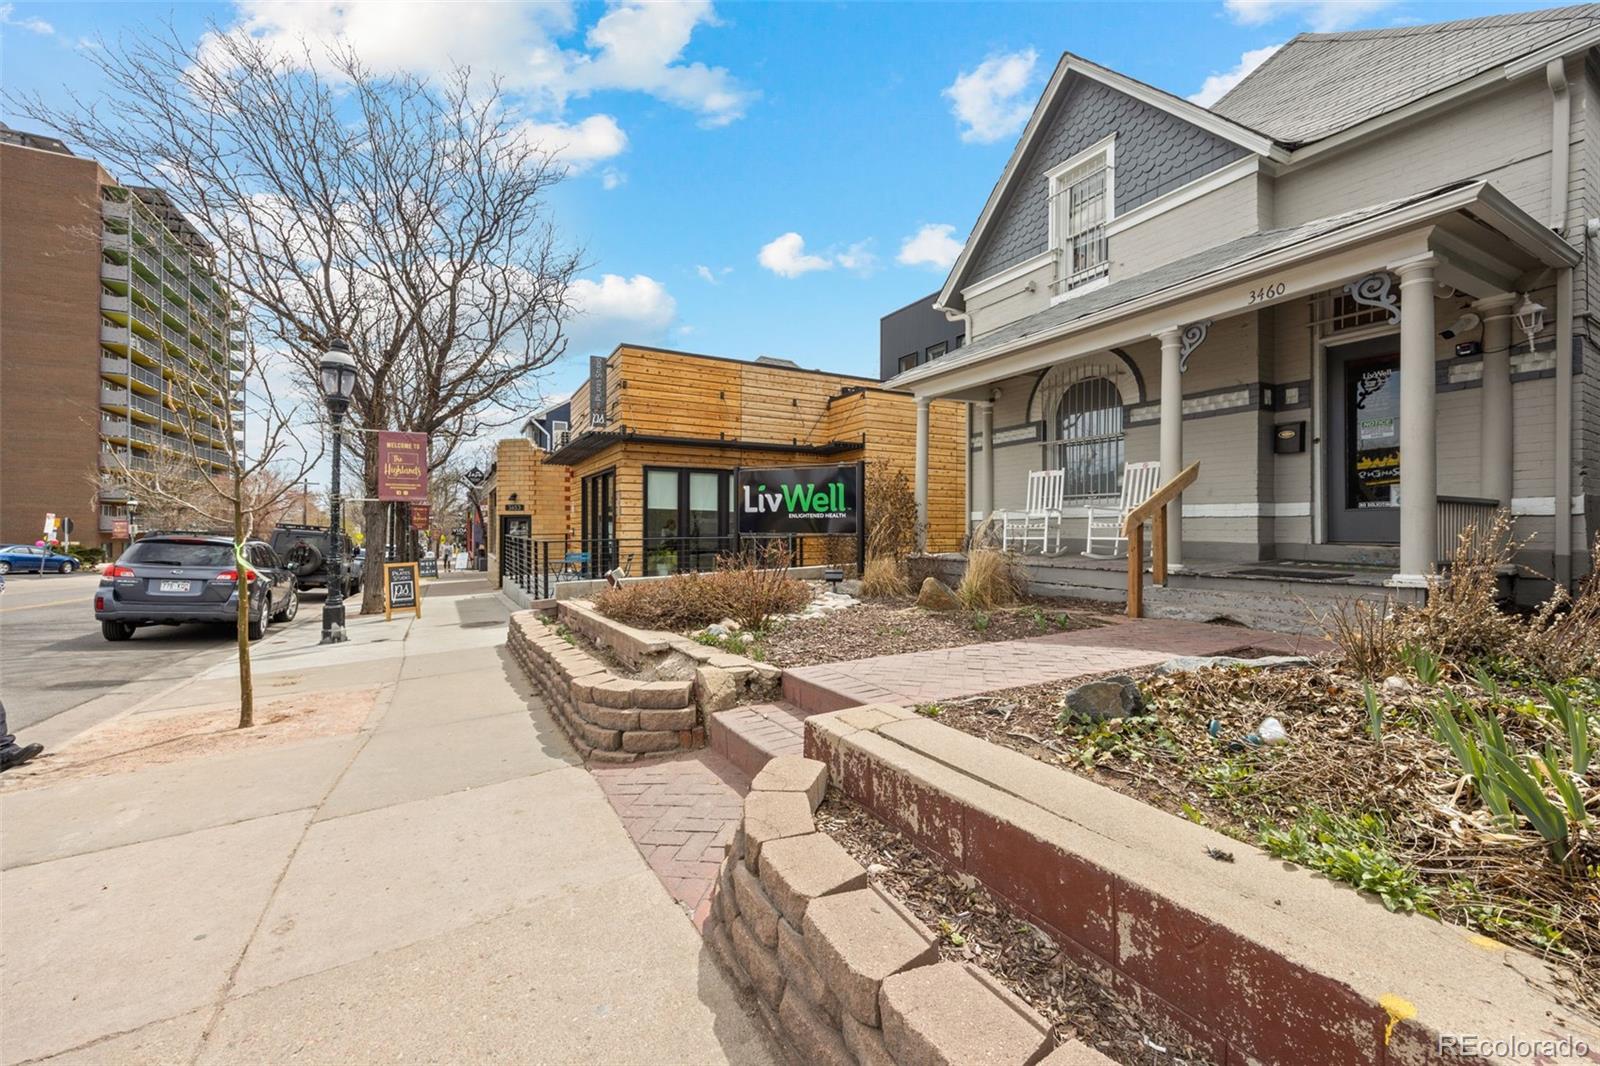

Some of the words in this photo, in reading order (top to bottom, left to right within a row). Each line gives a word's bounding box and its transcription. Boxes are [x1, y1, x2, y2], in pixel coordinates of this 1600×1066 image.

[1249, 282, 1286, 305] 3460
[386, 441, 412, 450] WELCOME
[413, 442, 421, 450] TO
[393, 454, 403, 463] The
[384, 462, 422, 477] Highlands
[743, 482, 847, 513] LivWell
